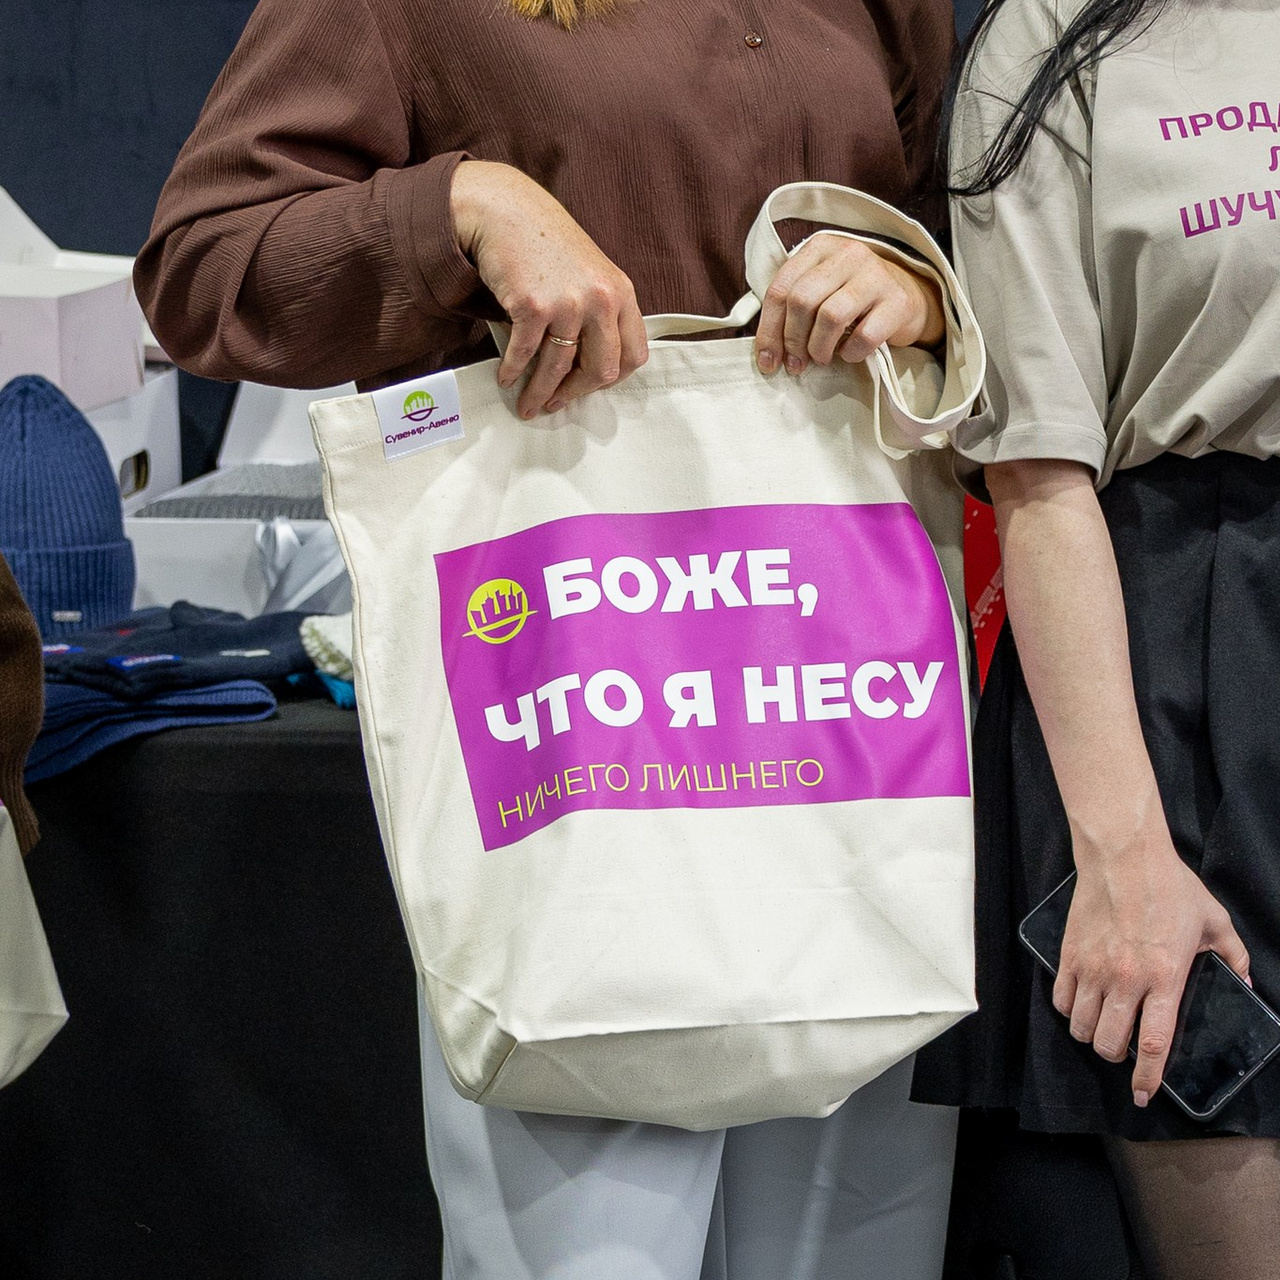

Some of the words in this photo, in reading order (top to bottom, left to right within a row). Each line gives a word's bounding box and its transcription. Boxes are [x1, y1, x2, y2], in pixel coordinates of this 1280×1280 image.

[385, 414, 460, 444] Сувенир-Авеню
[542, 548, 819, 620] БОЖЕ,
[484, 668, 644, 752] ЧТО
[662, 669, 718, 728] Я
[742, 660, 944, 724] НЕСУ
[498, 763, 630, 828] НИЧЕГО
[640, 758, 824, 792] ЛИШНЕГО
